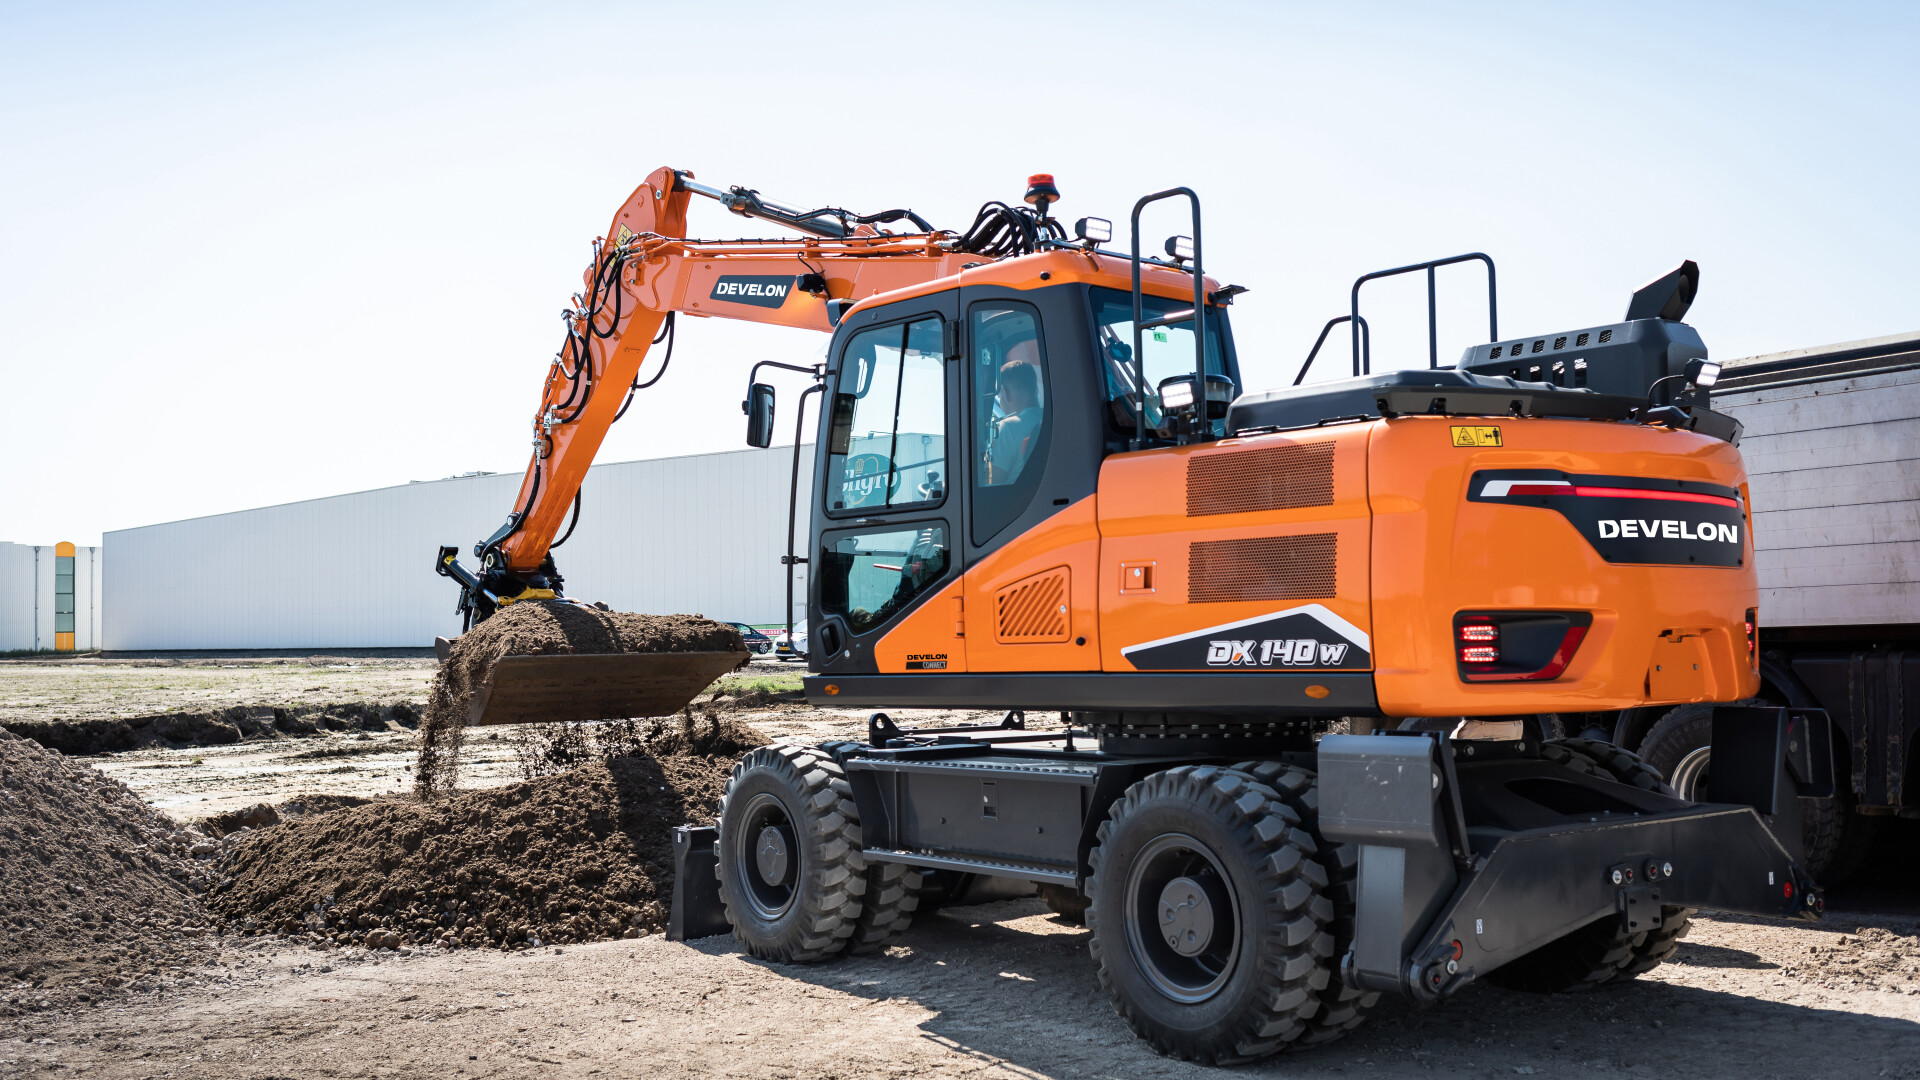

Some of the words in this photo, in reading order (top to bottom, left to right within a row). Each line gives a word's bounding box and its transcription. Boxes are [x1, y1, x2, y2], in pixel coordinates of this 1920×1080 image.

[716, 282, 787, 297] DEVELON
[1597, 519, 1738, 544] DEVELON
[906, 653, 948, 661] DEVELON
[1207, 640, 1257, 665] DX
[922, 661, 947, 669] CONNECT
